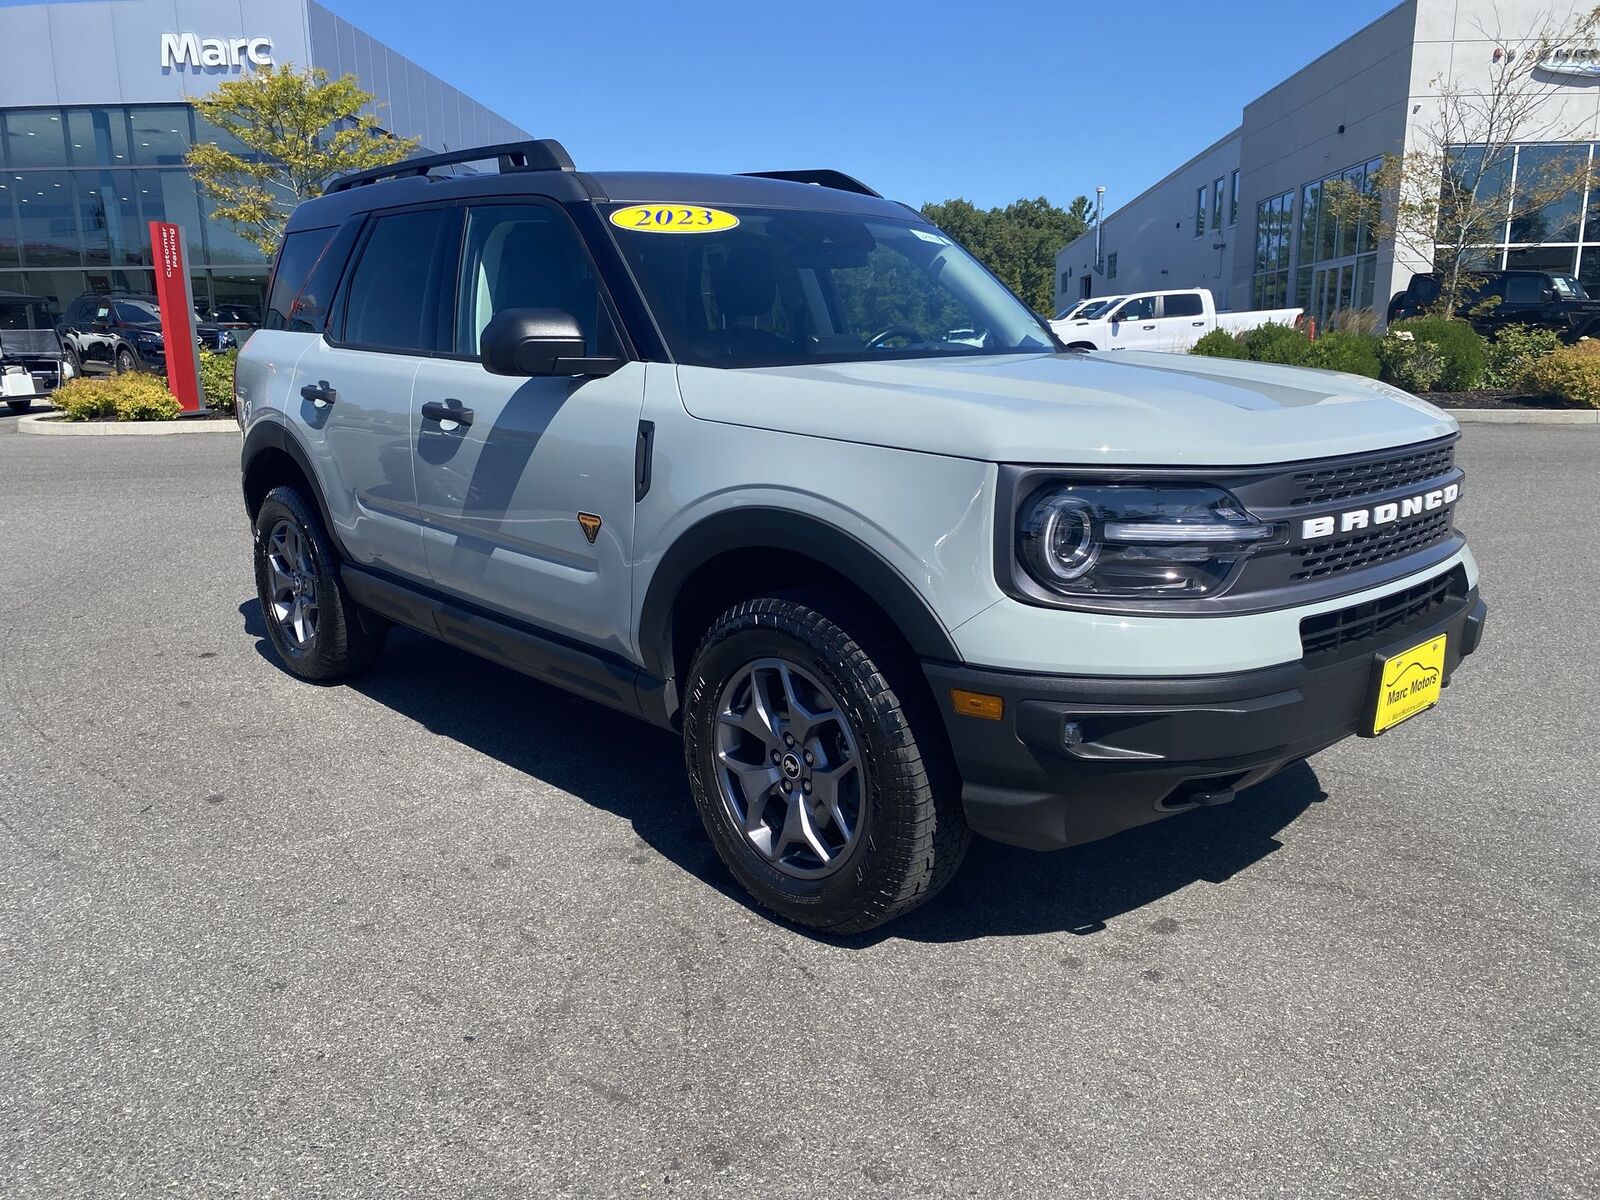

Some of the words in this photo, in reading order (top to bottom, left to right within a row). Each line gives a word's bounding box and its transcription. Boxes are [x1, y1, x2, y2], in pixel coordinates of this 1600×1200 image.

[161, 32, 272, 66] Marc
[635, 209, 713, 226] 2023
[162, 227, 172, 278] Customer
[170, 228, 178, 268] Parking
[1302, 484, 1459, 540] BRONCO
[1387, 688, 1408, 706] Marc
[1410, 673, 1437, 695] Motors
